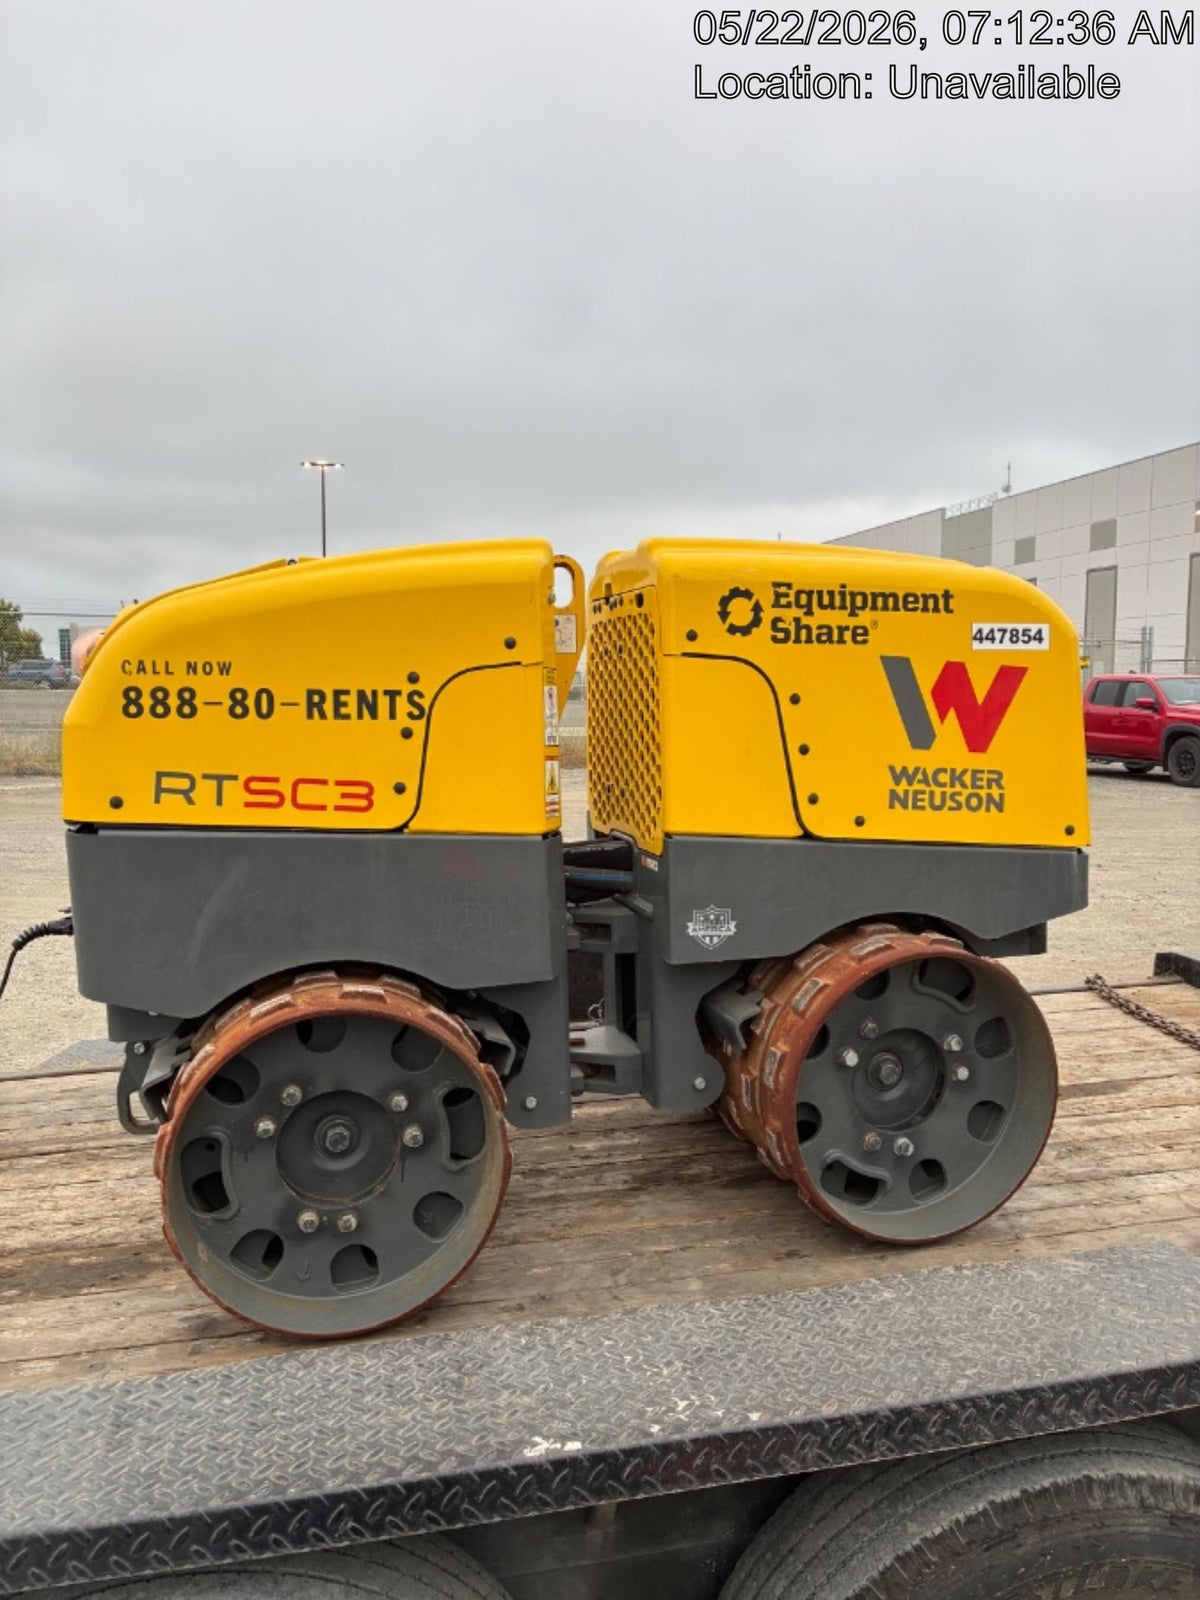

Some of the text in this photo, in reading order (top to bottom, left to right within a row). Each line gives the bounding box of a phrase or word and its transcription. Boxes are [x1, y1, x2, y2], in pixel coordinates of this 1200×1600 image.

[771, 581, 954, 617] Equipment
[972, 627, 1044, 645] 447854
[121, 659, 232, 677] CALL NOW
[121, 685, 426, 721] 888-80-RENTS
[887, 764, 1005, 791] WACKER
[153, 770, 375, 813] RTSC3
[887, 788, 1005, 814] NEUSON
